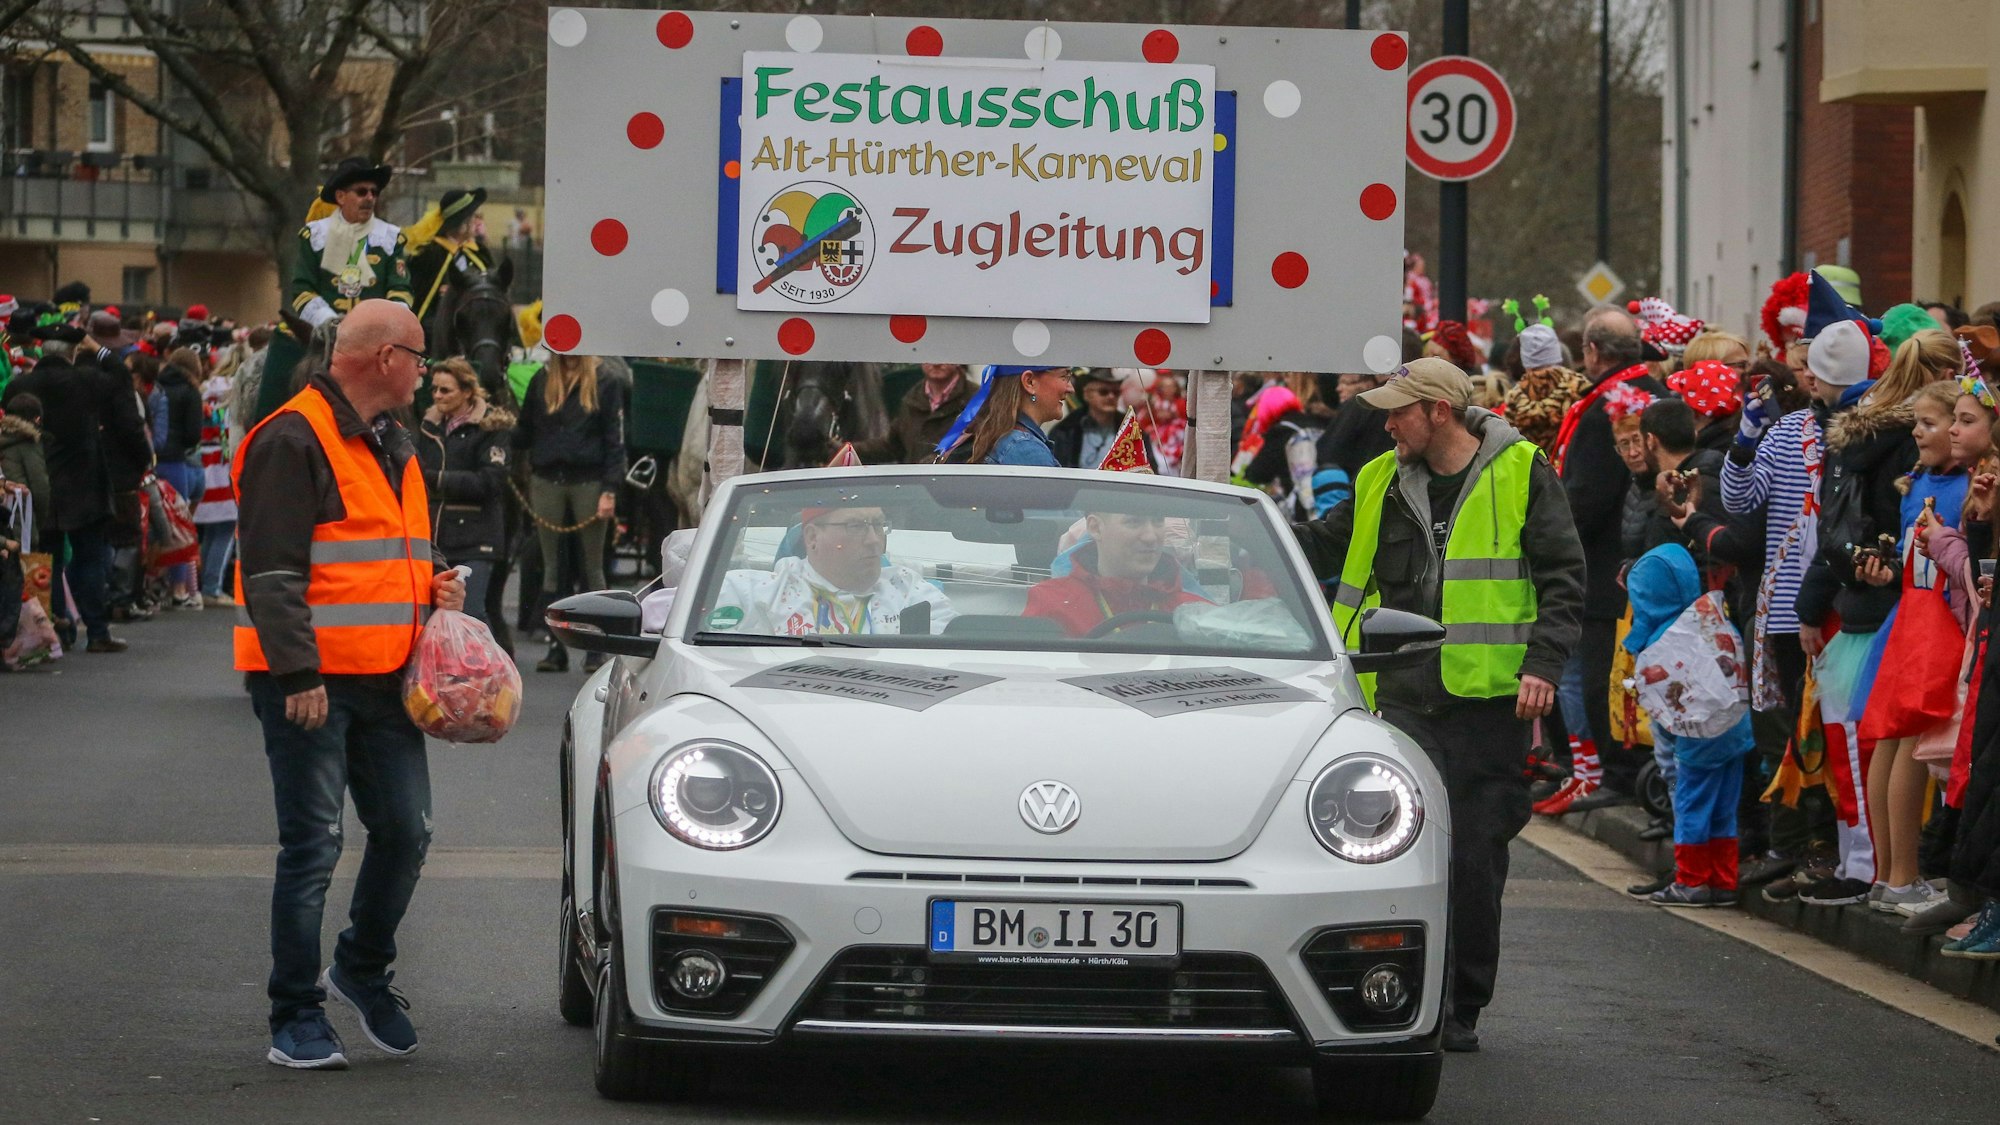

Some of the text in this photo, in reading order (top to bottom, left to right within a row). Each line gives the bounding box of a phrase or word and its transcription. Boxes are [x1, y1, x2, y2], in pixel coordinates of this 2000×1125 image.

[752, 66, 1205, 132] Festausschuß
[1420, 91, 1487, 146] 30
[751, 136, 1203, 183] Alt-Hürther-Karneval
[889, 207, 1204, 276] Zugleitung
[780, 281, 835, 300] SEIT 1930
[777, 663, 959, 692] Klinkhammer
[1102, 676, 1264, 698] Klinkhammer
[812, 682, 832, 691] in
[837, 685, 890, 700] Hürth
[1177, 699, 1194, 707] 2
[1208, 693, 1227, 702] in
[1226, 691, 1281, 702] Hürth
[938, 931, 948, 943] D
[973, 908, 1158, 948] BM II 30
[978, 955, 1129, 966] www.bautz-klinkhammer.de Hürth/Köln
